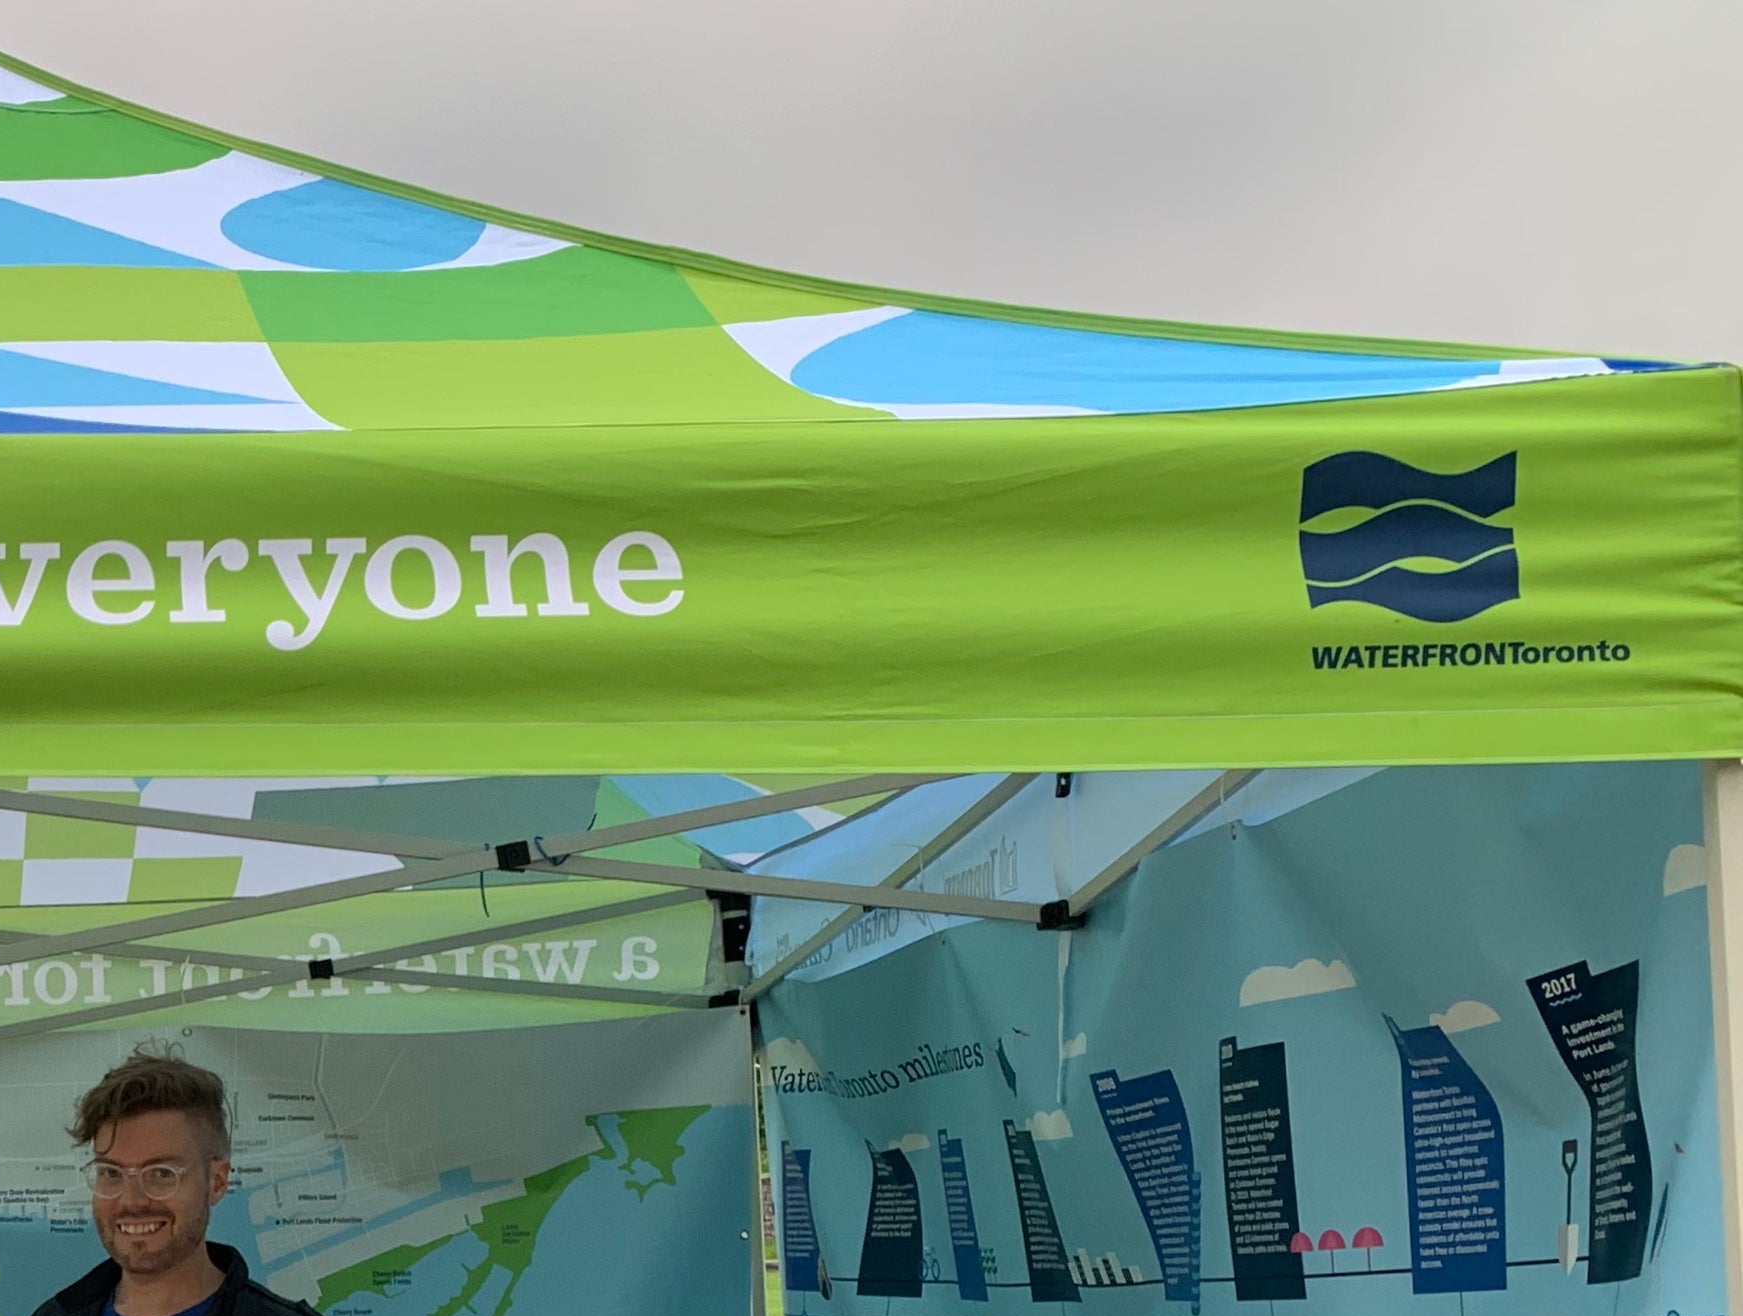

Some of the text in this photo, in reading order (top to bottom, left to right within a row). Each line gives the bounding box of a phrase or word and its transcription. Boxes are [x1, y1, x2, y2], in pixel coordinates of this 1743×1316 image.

[1312, 640, 1630, 669] WATERFRONToronto
[1542, 973, 1576, 998] 2017
[1572, 1047, 1593, 1060] Port
